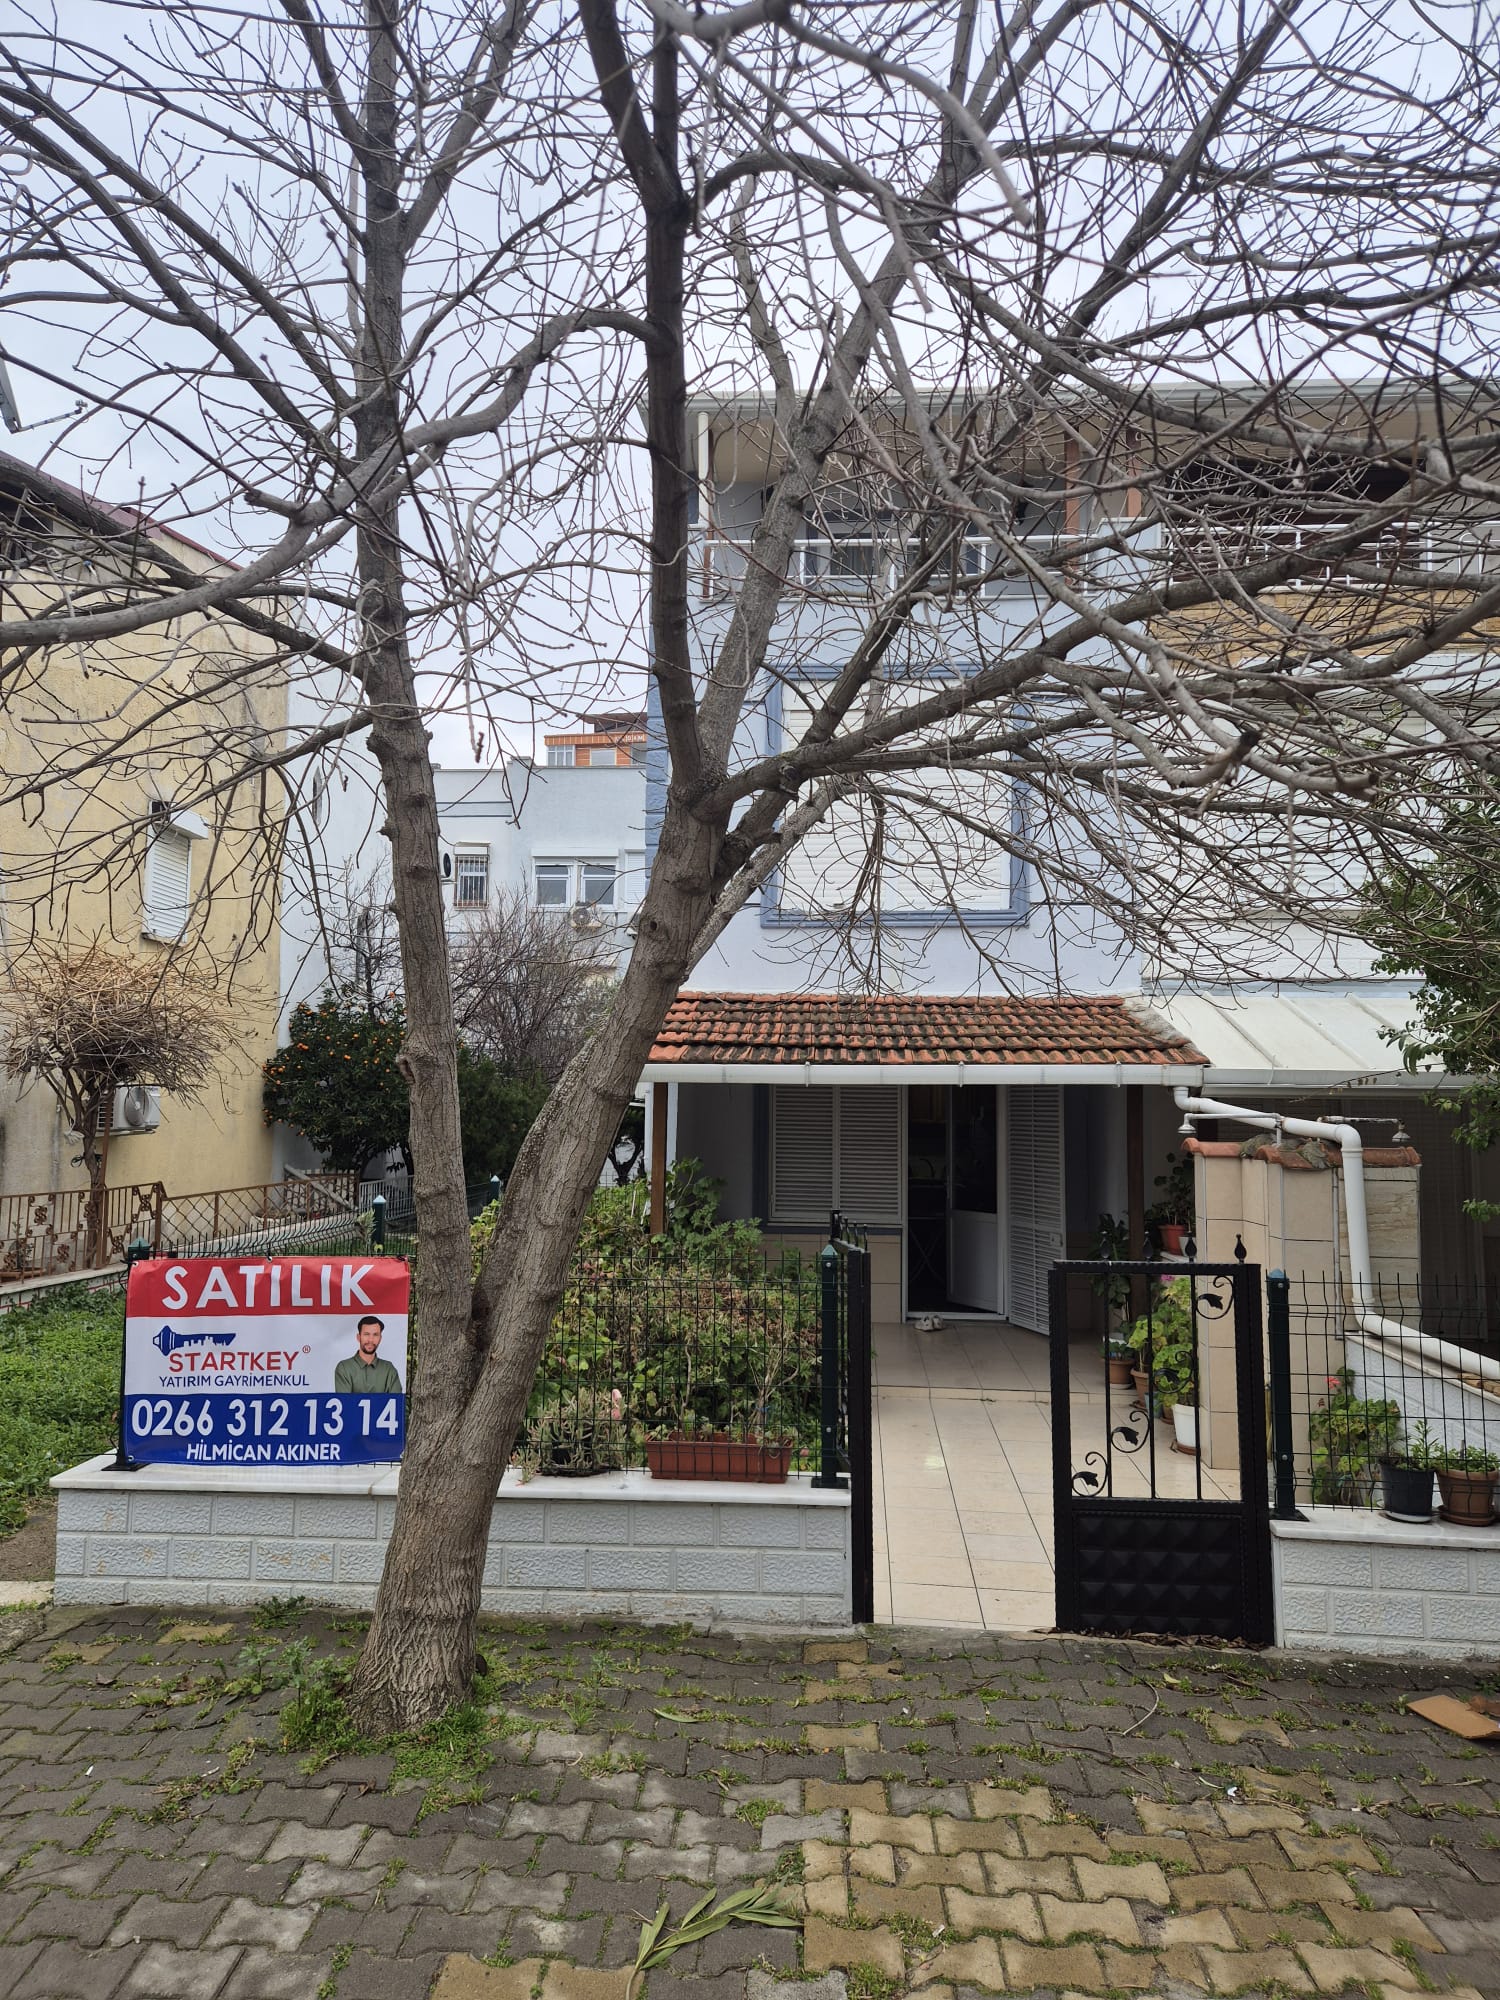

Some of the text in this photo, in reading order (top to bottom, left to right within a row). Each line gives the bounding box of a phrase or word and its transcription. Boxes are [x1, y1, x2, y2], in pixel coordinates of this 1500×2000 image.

[162, 1264, 375, 1310] SATILIK
[159, 1372, 310, 1387] YATIRIM GAYRİMENKUL
[132, 1398, 398, 1436] 0266 312 13 14
[186, 1439, 340, 1461] HİLMİCAN AKINER
